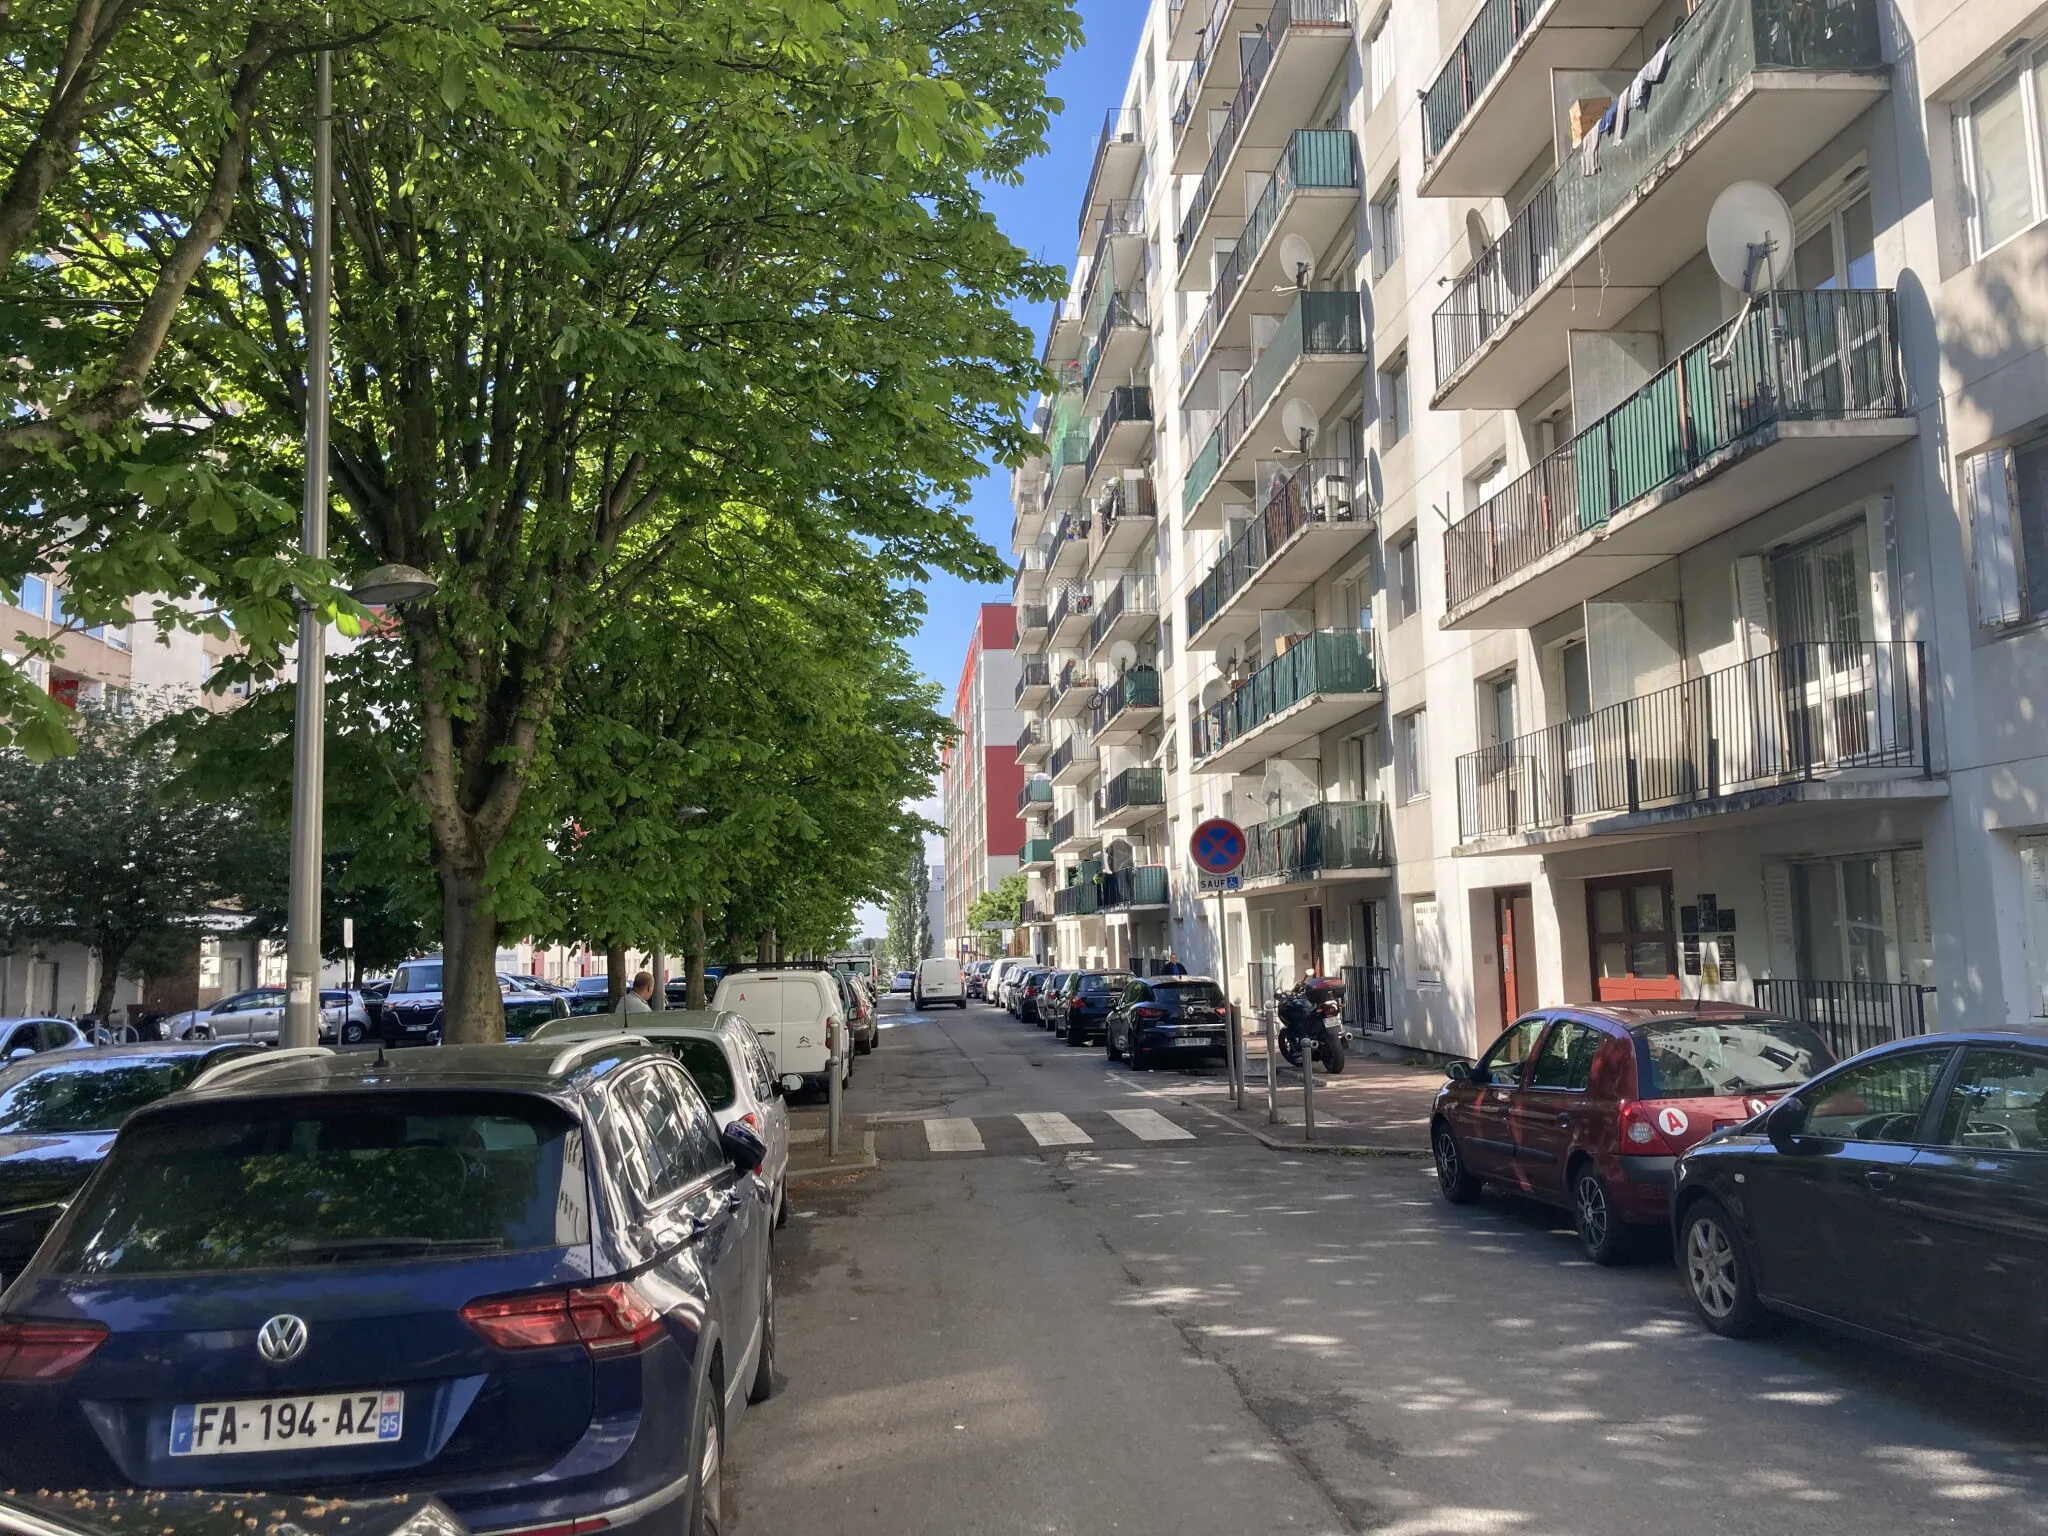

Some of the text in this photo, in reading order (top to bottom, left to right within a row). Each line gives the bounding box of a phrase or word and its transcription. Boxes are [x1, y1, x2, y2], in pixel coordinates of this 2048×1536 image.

[1200, 879, 1226, 889] SAUF
[739, 992, 746, 1002] A
[1665, 1111, 1684, 1132] A
[258, 1314, 307, 1361] VW
[197, 1396, 378, 1446] FA-194-AZ
[380, 1415, 398, 1433] 95
[178, 1432, 187, 1443] F
